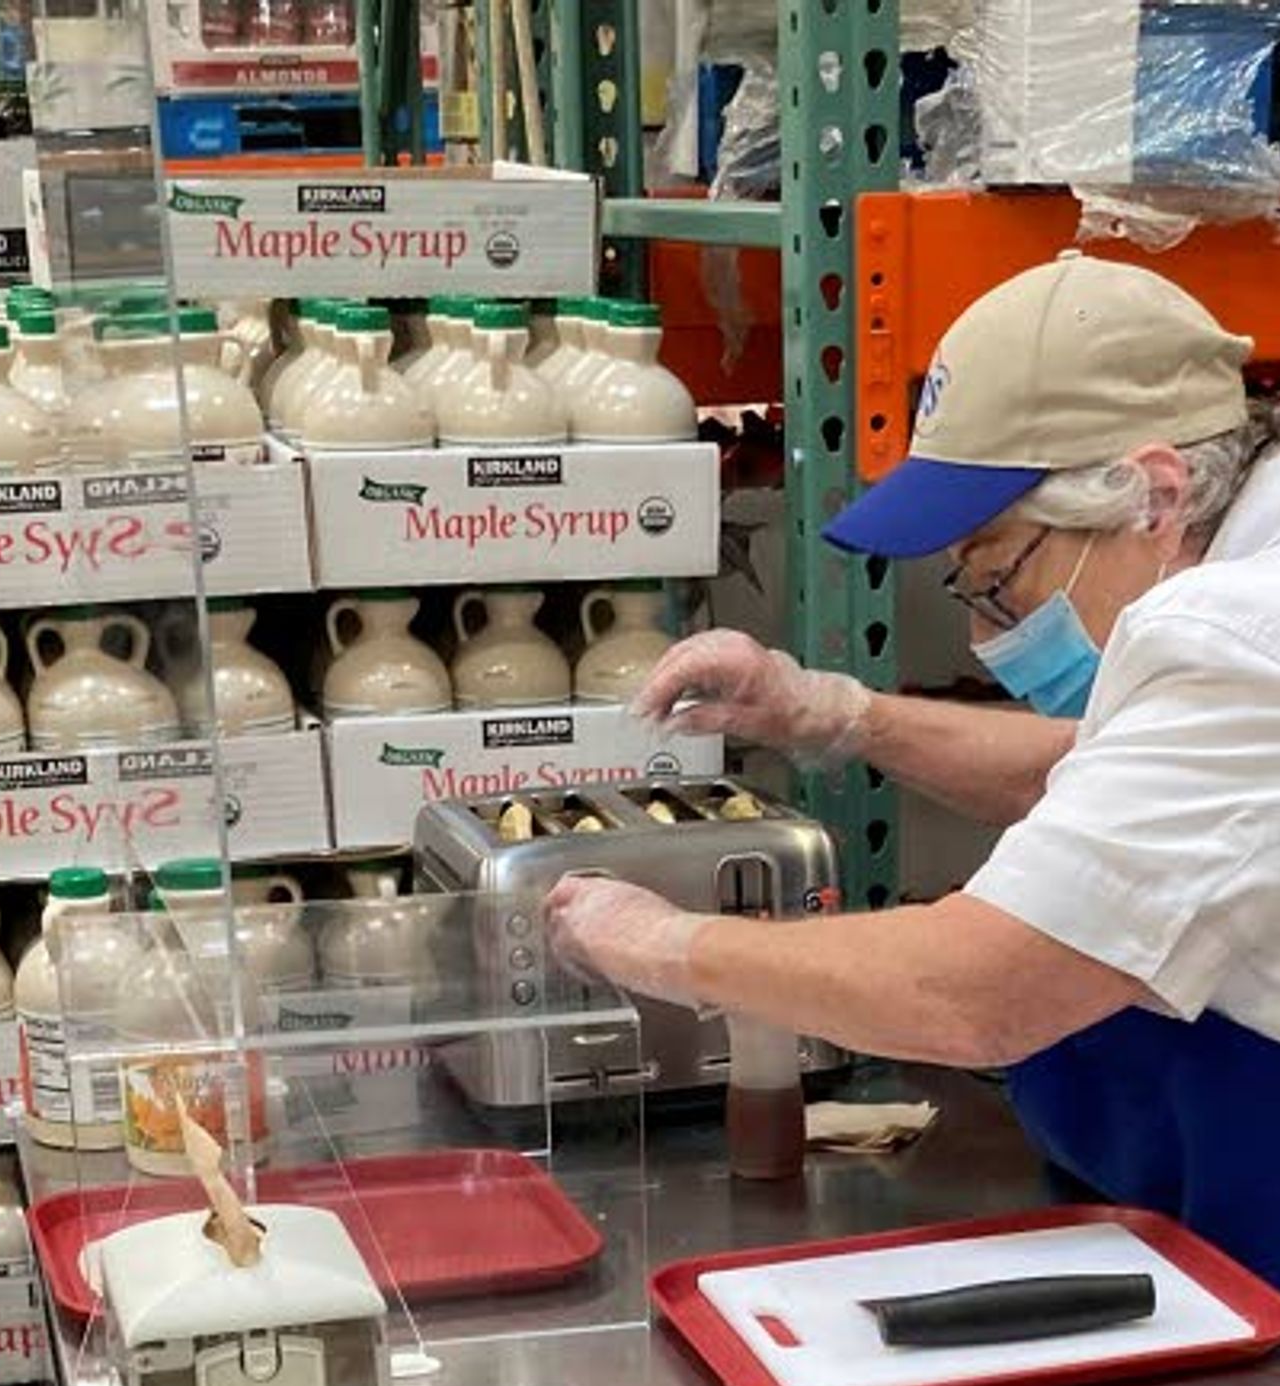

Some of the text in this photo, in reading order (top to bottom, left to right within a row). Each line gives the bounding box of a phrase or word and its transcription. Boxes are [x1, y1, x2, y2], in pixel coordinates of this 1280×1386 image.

[300, 187, 384, 204] KIRKLAND
[215, 220, 468, 270] Maple Syrup
[471, 458, 559, 476] KIRKLAND
[403, 501, 629, 548] Maple Syrup
[486, 719, 571, 737] KIRKLAND
